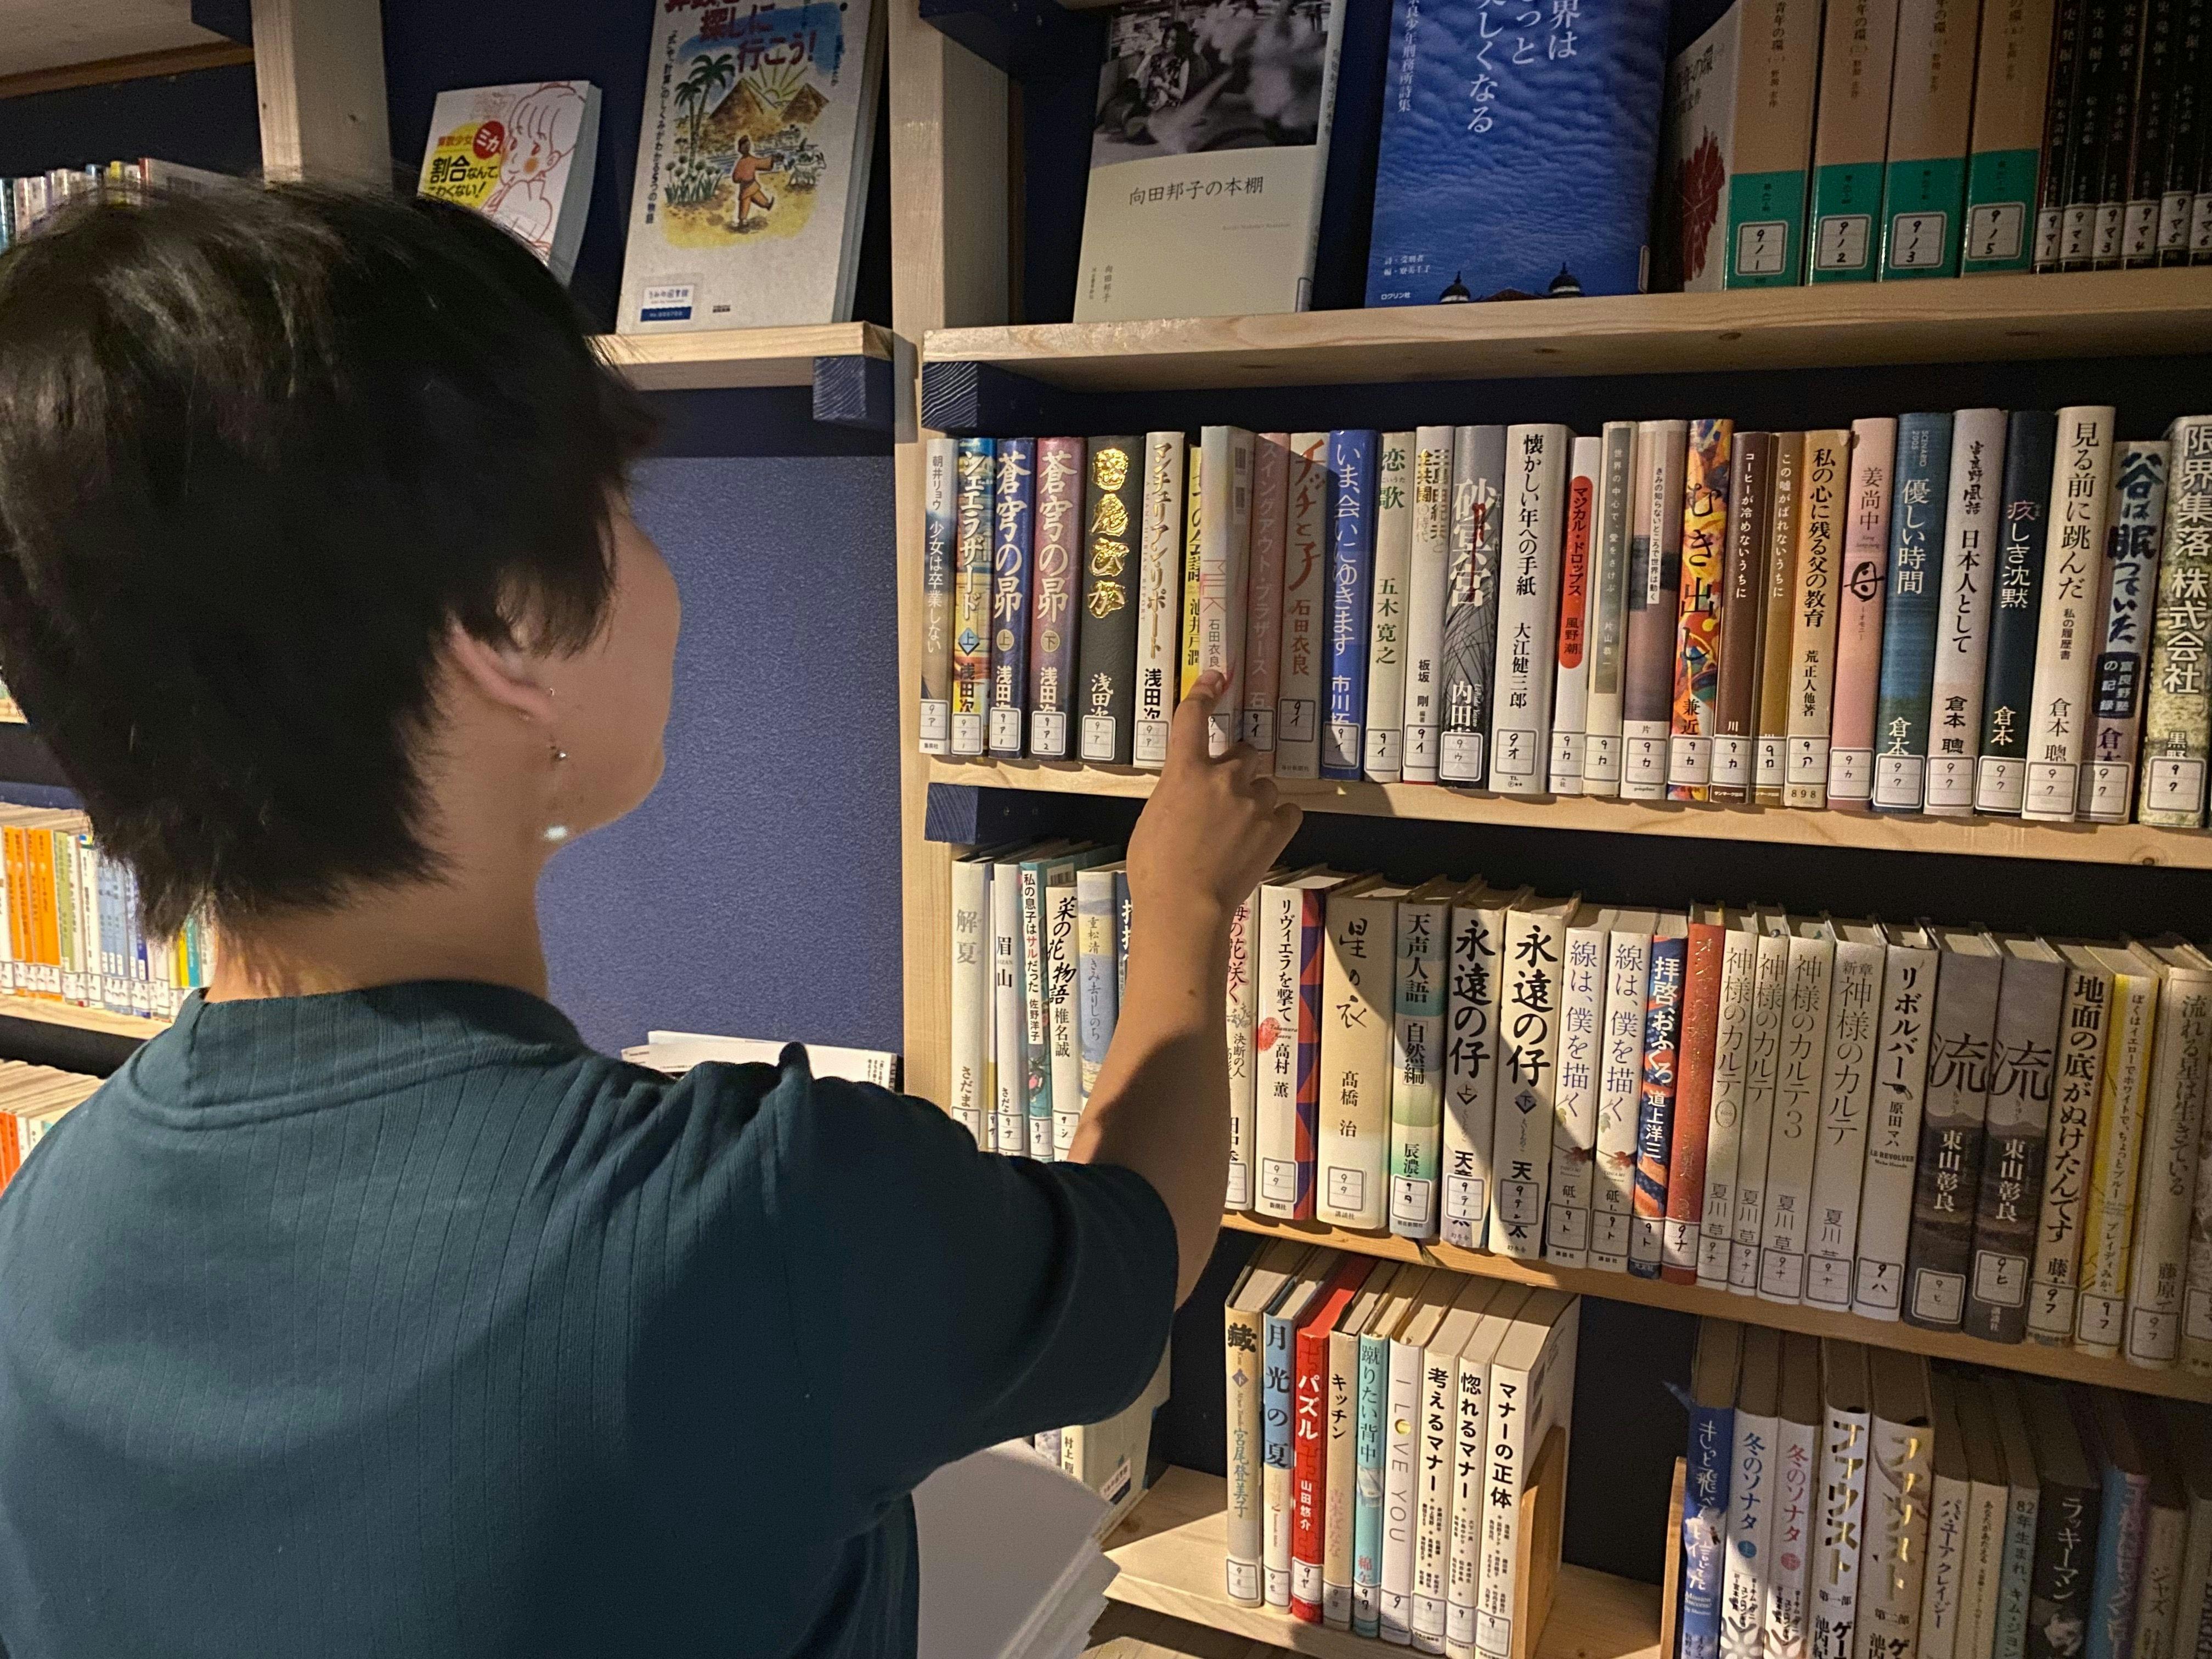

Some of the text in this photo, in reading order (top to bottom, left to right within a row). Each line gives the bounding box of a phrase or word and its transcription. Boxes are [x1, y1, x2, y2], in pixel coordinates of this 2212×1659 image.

[477, 129, 500, 153] ミカ
[1129, 175, 1264, 206] 向田邦子の本棚
[927, 455, 945, 653] 朝井リョウ 少女は卒業しない
[960, 450, 986, 620] シェエラザード
[994, 450, 1032, 646] 蒼穹の昴 上
[1037, 450, 1079, 650] 蒼穹の昴 下
[1331, 444, 1361, 656] いま、会いにゆきます
[1375, 448, 1406, 664] 恋歌 五木寛之
[1416, 449, 1434, 543] 全共闘の時代
[1430, 449, 1449, 554] 三島由紀夫と
[1602, 448, 1623, 665] 世界の中心で、愛をさけぶ 片山恭一
[1650, 467, 1663, 601] きみの知らないところで世界は動く
[1736, 453, 1755, 599] コーヒーが冷めないうちに
[1773, 454, 1792, 598] この嘘がばれないうちに
[1804, 448, 1836, 628] 私の心に残る父の教育
[1860, 467, 1883, 531] 姜尚中
[1897, 478, 1931, 595] 優しい時間
[2058, 421, 2100, 601] 見る前に跳んだ
[2106, 452, 2165, 644] 谷は眠っていた
[2163, 425, 2212, 694] 限界集落株式会社
[1202, 560, 1226, 613] MILK
[1509, 434, 1544, 709] 懐かしい年への手紙 大江健三郎
[1564, 486, 1588, 654] マジカル・ドロップス 風野潮
[1953, 529, 1980, 653] 日本人として
[1990, 499, 2037, 746] 疚しき沈黙 倉本
[962, 632, 975, 646] 上
[1208, 619, 1221, 668] 石田衣良
[1291, 599, 1311, 676] 石田衣良
[1418, 659, 1431, 682] 板坂
[2059, 608, 2075, 661] 私の履歴書
[1509, 733, 1519, 747] 9
[1681, 698, 1701, 735] 兼近
[1943, 695, 1968, 729] 倉本
[2046, 697, 2072, 738] 倉本
[956, 909, 979, 965] 解夏
[996, 936, 1013, 988] 眉山
[1024, 873, 1040, 1041] 私の息子はサルだった 佐野洋子
[1047, 896, 1077, 1058] 菜の花物語 椎名誠
[1087, 917, 1102, 1041] 重松清 きみ去りしのち
[1276, 899, 1295, 1023] リヴィエラを撃て
[1336, 918, 1368, 1029] 星の衣
[1406, 913, 1431, 1003] 天声人語
[1274, 1043, 1290, 1075] 高村
[1404, 1022, 1426, 1086] 自然編
[1448, 919, 1497, 1096] 永遠の仔 上
[1505, 924, 1559, 1105] 永遠の仔 下
[1562, 940, 1598, 1118] 線は、僕を描く
[1606, 943, 1644, 1122] 線は、僕を描く
[1645, 956, 1680, 1160] 拝啓、おふくろ 道上洋三
[1748, 953, 1784, 1103] 神様のカルテ
[1827, 961, 1874, 1146] 新章 神様のカルテ
[1884, 967, 1922, 1147] リボルバー 原田マハ
[1878, 1151, 1914, 1163] REVOLVER
[1929, 1032, 1990, 1213] 流 東山彰良
[1990, 1039, 2052, 1223] 流 東山彰良
[2046, 974, 2105, 1243] 地面の底がぬけたんです
[2168, 994, 2208, 1197] 流れる星は生きている
[1265, 1324, 1290, 1469] 月光の夏
[1297, 1374, 1321, 1532] パズル 山田悠介
[1330, 1373, 1347, 1440] キッチン
[1359, 1345, 1380, 1463] 蹴りたい背中
[1425, 1367, 1449, 1492] 考えるマナー
[1458, 1372, 1482, 1499] 惚れるマナー
[1490, 1382, 1517, 1510] マナーの正体
[1233, 1427, 1249, 1519] 宮尾登美子
[1389, 1403, 1412, 1543] LOVE YOU
[1740, 1432, 1765, 1531] 冬のソナタ
[1783, 1443, 1809, 1543] 冬のソナタ
[2053, 1497, 2084, 1600] ラッキーマン
